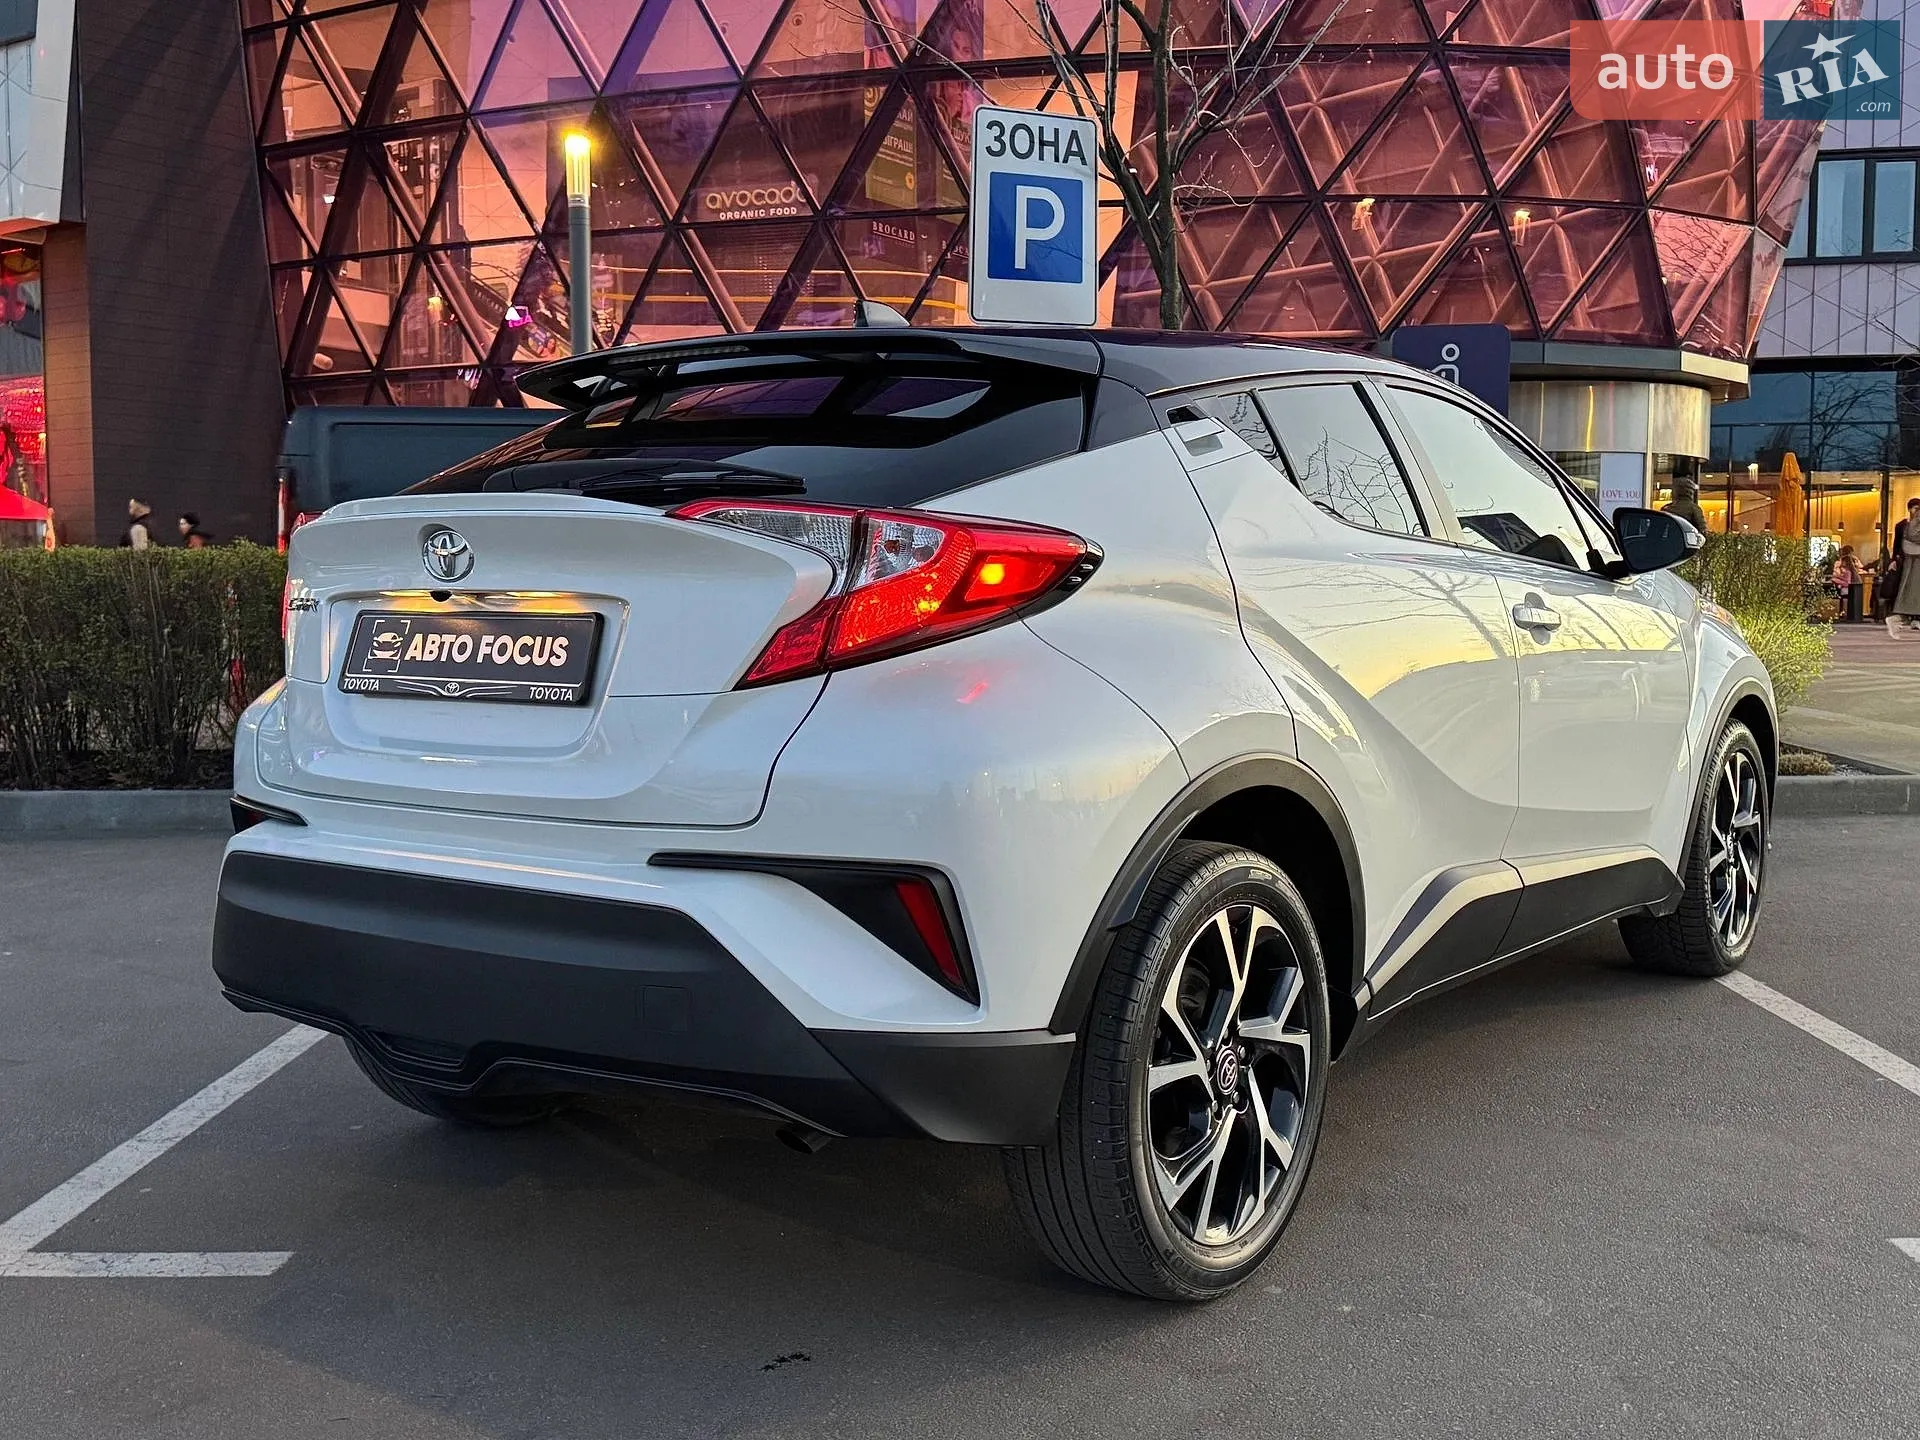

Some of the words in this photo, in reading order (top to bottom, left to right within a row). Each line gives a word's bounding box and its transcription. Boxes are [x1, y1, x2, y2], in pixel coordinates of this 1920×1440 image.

[985, 120, 1088, 166] ЗОНА
[720, 209, 766, 220] ORGANIC
[770, 207, 797, 216] FOOD
[872, 221, 915, 241] BROCARD
[1015, 185, 1065, 270] P
[404, 633, 473, 663] АВТО
[476, 634, 569, 667] FOCUS
[343, 678, 379, 691] TOYOTA
[529, 686, 573, 701] TOYOTA
